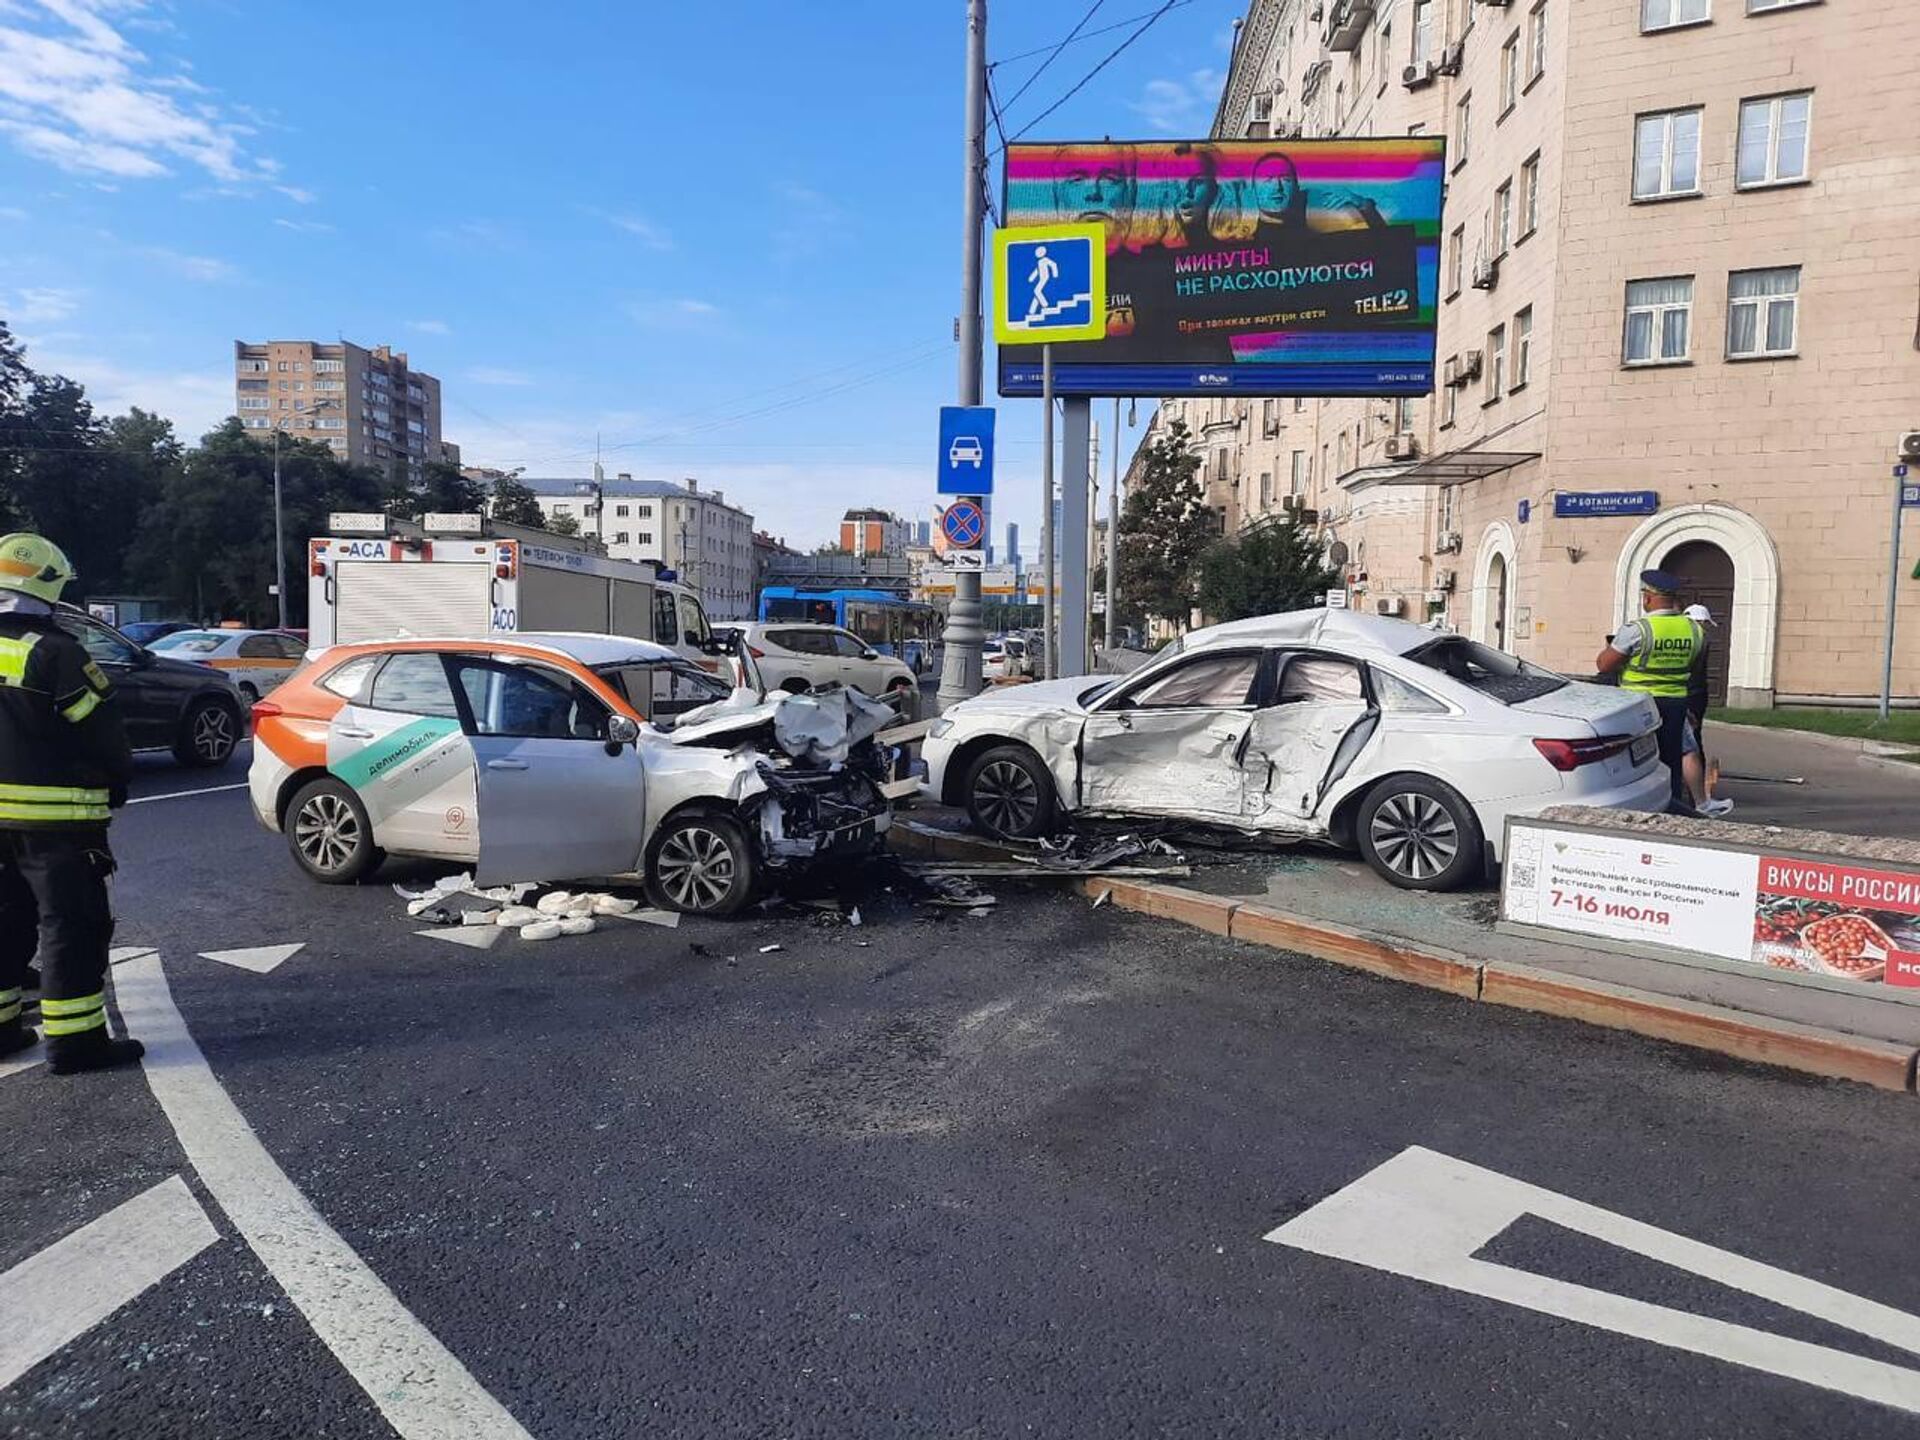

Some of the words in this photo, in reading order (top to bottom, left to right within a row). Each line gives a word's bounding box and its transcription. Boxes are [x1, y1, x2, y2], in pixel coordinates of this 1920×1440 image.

[1175, 248, 1270, 273] МИНУТЫ
[1176, 278, 1206, 297] НЕ
[1210, 259, 1375, 292] РАСХОДУЮТСЯ
[1354, 289, 1410, 314] TELE2
[1300, 309, 1327, 320] сети
[1579, 495, 1644, 507] БОТКИНСКИЙ
[349, 542, 386, 558] АСА
[492, 608, 516, 630] АСО
[1654, 637, 1692, 651] ЦОДД
[368, 730, 438, 777] делимобиль
[1551, 876, 1607, 892] фестиваль
[1552, 863, 1629, 881] Национальный
[1630, 876, 1741, 898] гастрономический
[1767, 866, 1835, 894] ВКУСЫ
[1550, 889, 1599, 914] 7-16
[1604, 902, 1671, 926] июля
